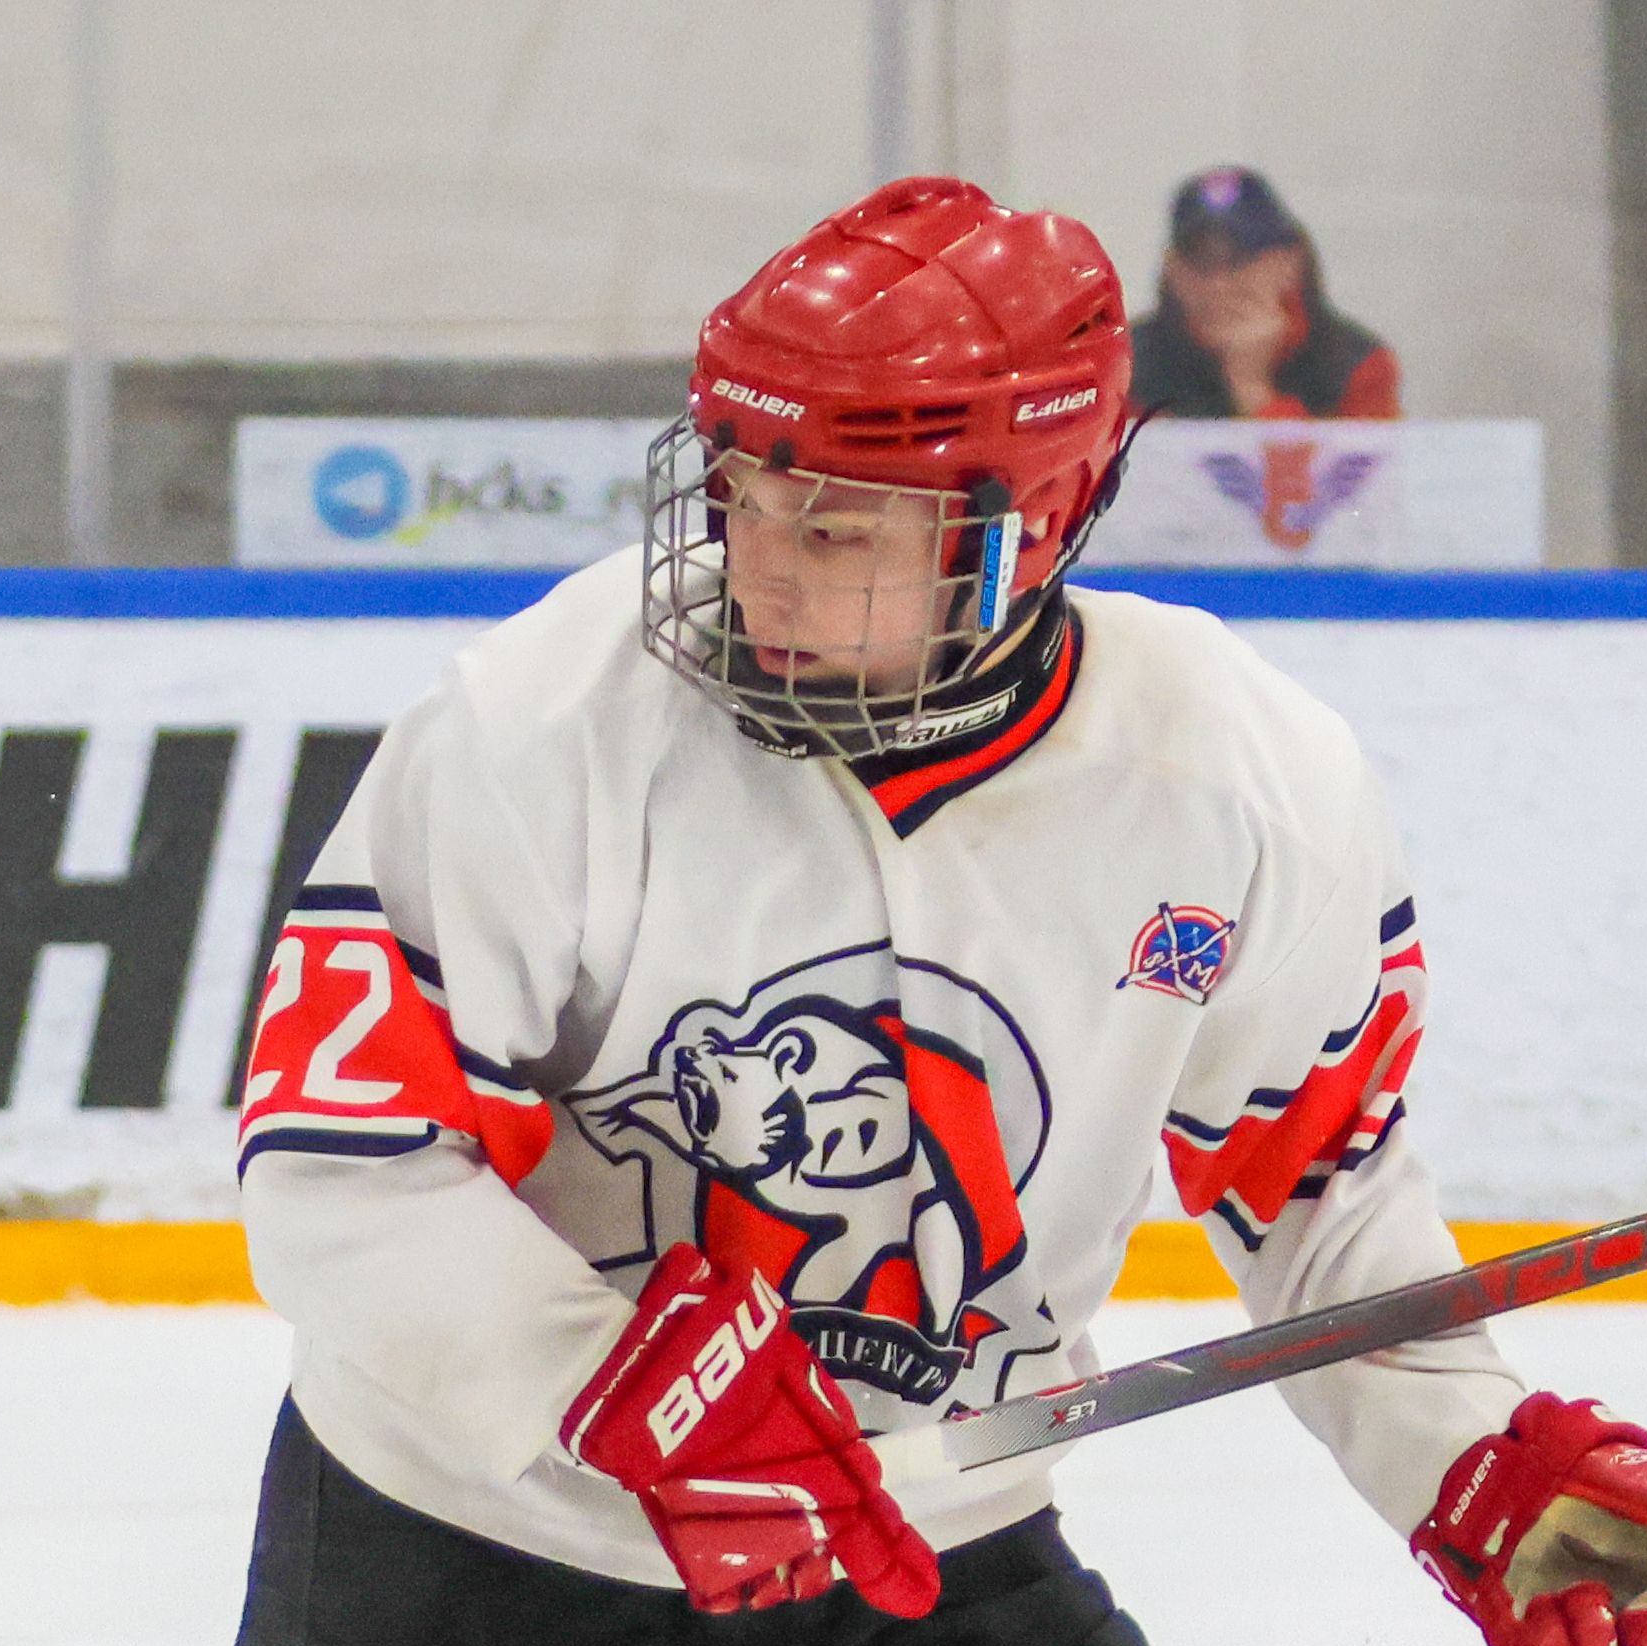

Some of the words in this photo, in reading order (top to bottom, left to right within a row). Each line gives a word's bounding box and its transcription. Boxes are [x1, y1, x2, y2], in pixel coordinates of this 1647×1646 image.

[711, 377, 806, 421] BAUER
[242, 935, 404, 1106] 22
[647, 1267, 786, 1459] BAU
[1449, 1449, 1498, 1526] BAUER
